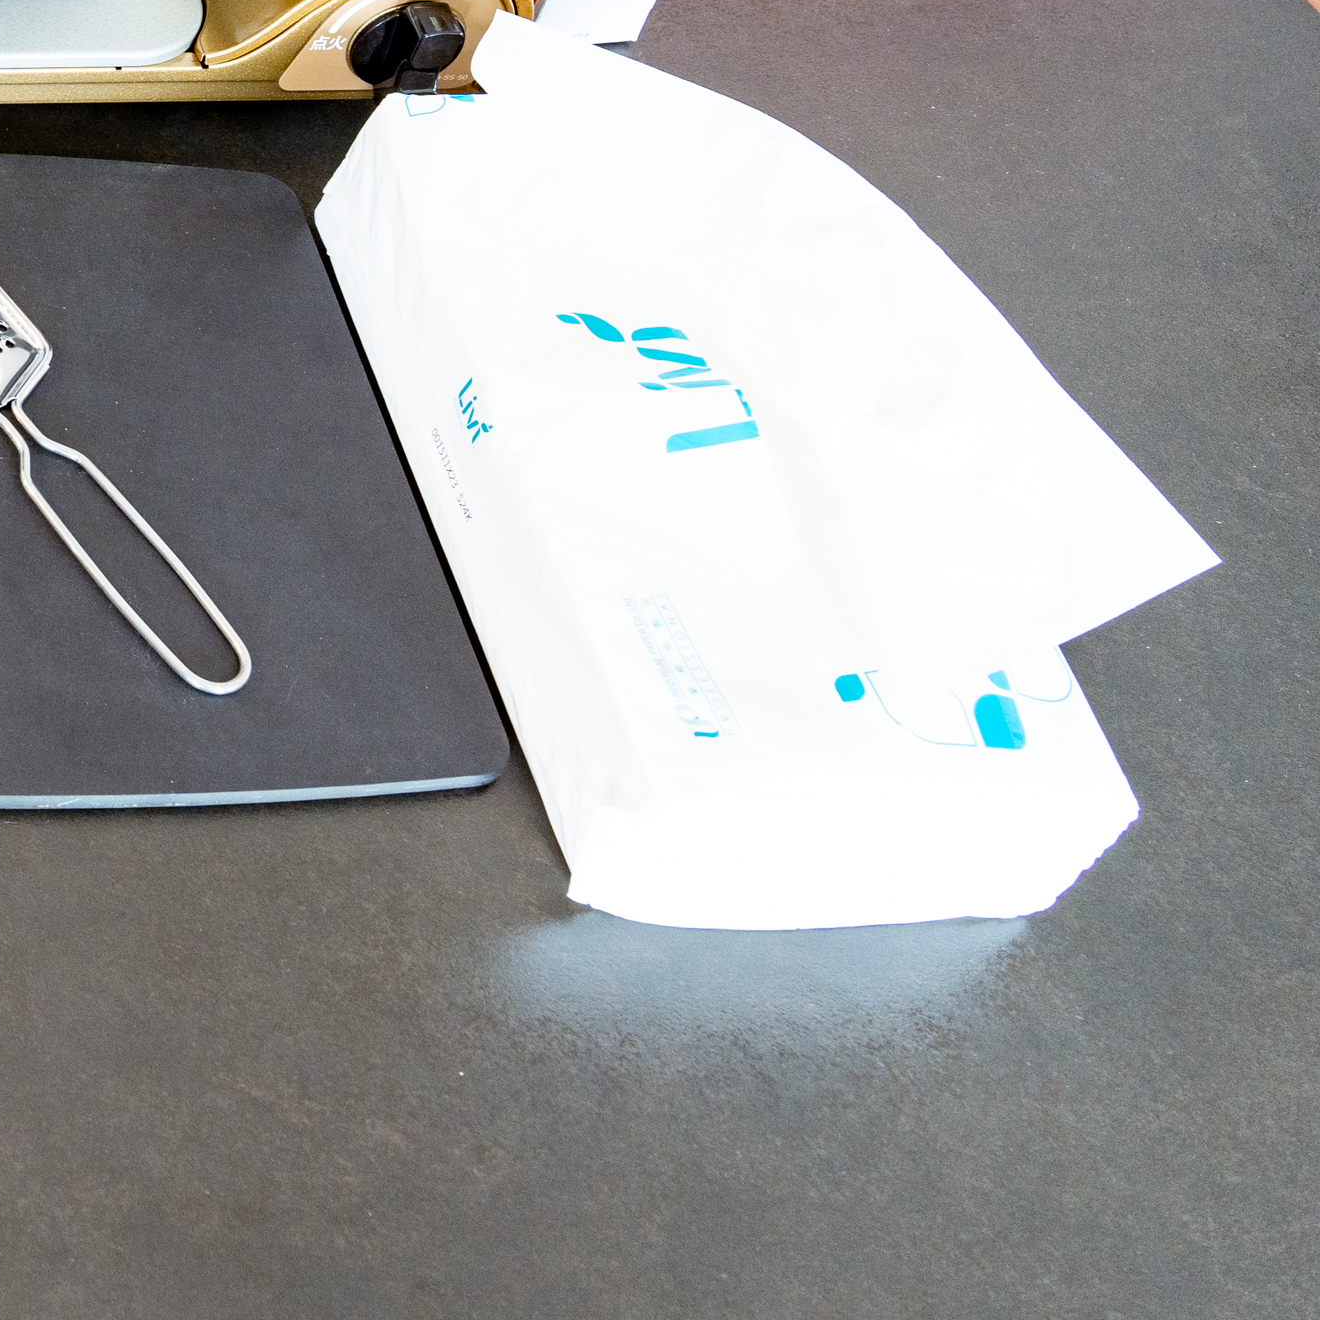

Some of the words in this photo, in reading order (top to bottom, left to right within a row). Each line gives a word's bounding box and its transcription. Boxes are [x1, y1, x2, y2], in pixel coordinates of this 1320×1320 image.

[309, 35, 347, 51] 点火
[436, 73, 468, 82] -SS-50
[458, 378, 492, 445] Livi
[637, 627, 658, 655] PAPER
[653, 656, 683, 702] UNIVERSAL
[654, 591, 738, 737] PROFESSIONAL
